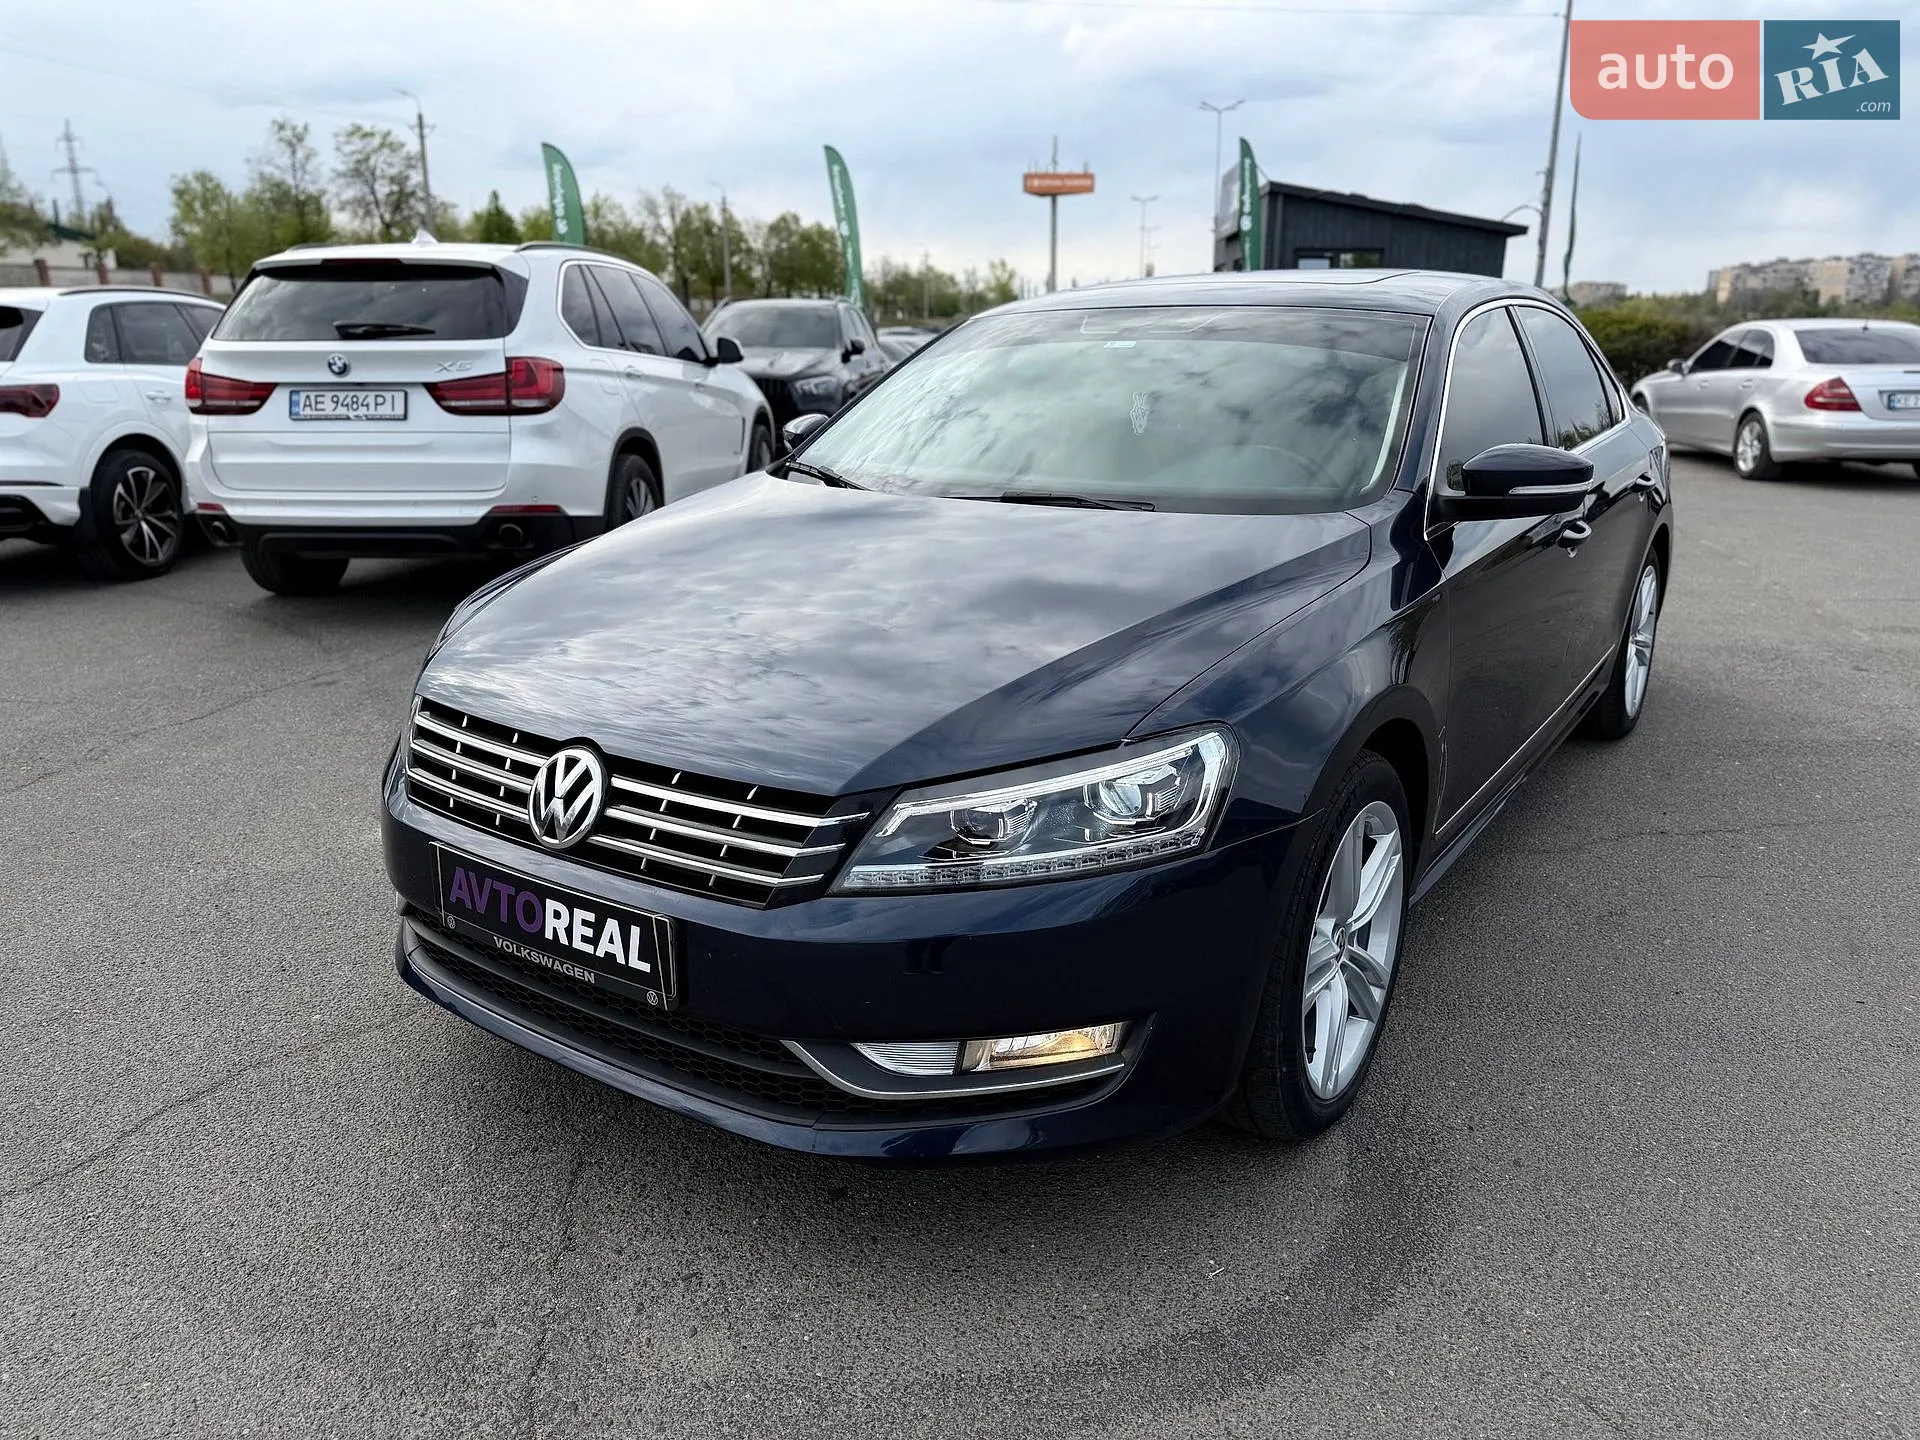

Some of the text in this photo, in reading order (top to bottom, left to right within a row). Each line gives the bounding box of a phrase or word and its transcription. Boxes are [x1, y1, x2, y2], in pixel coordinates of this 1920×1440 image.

[302, 394, 395, 413] AE 9484 PI
[449, 866, 651, 973] AVTOREAL
[493, 936, 596, 984] VOLKSWAGEN
